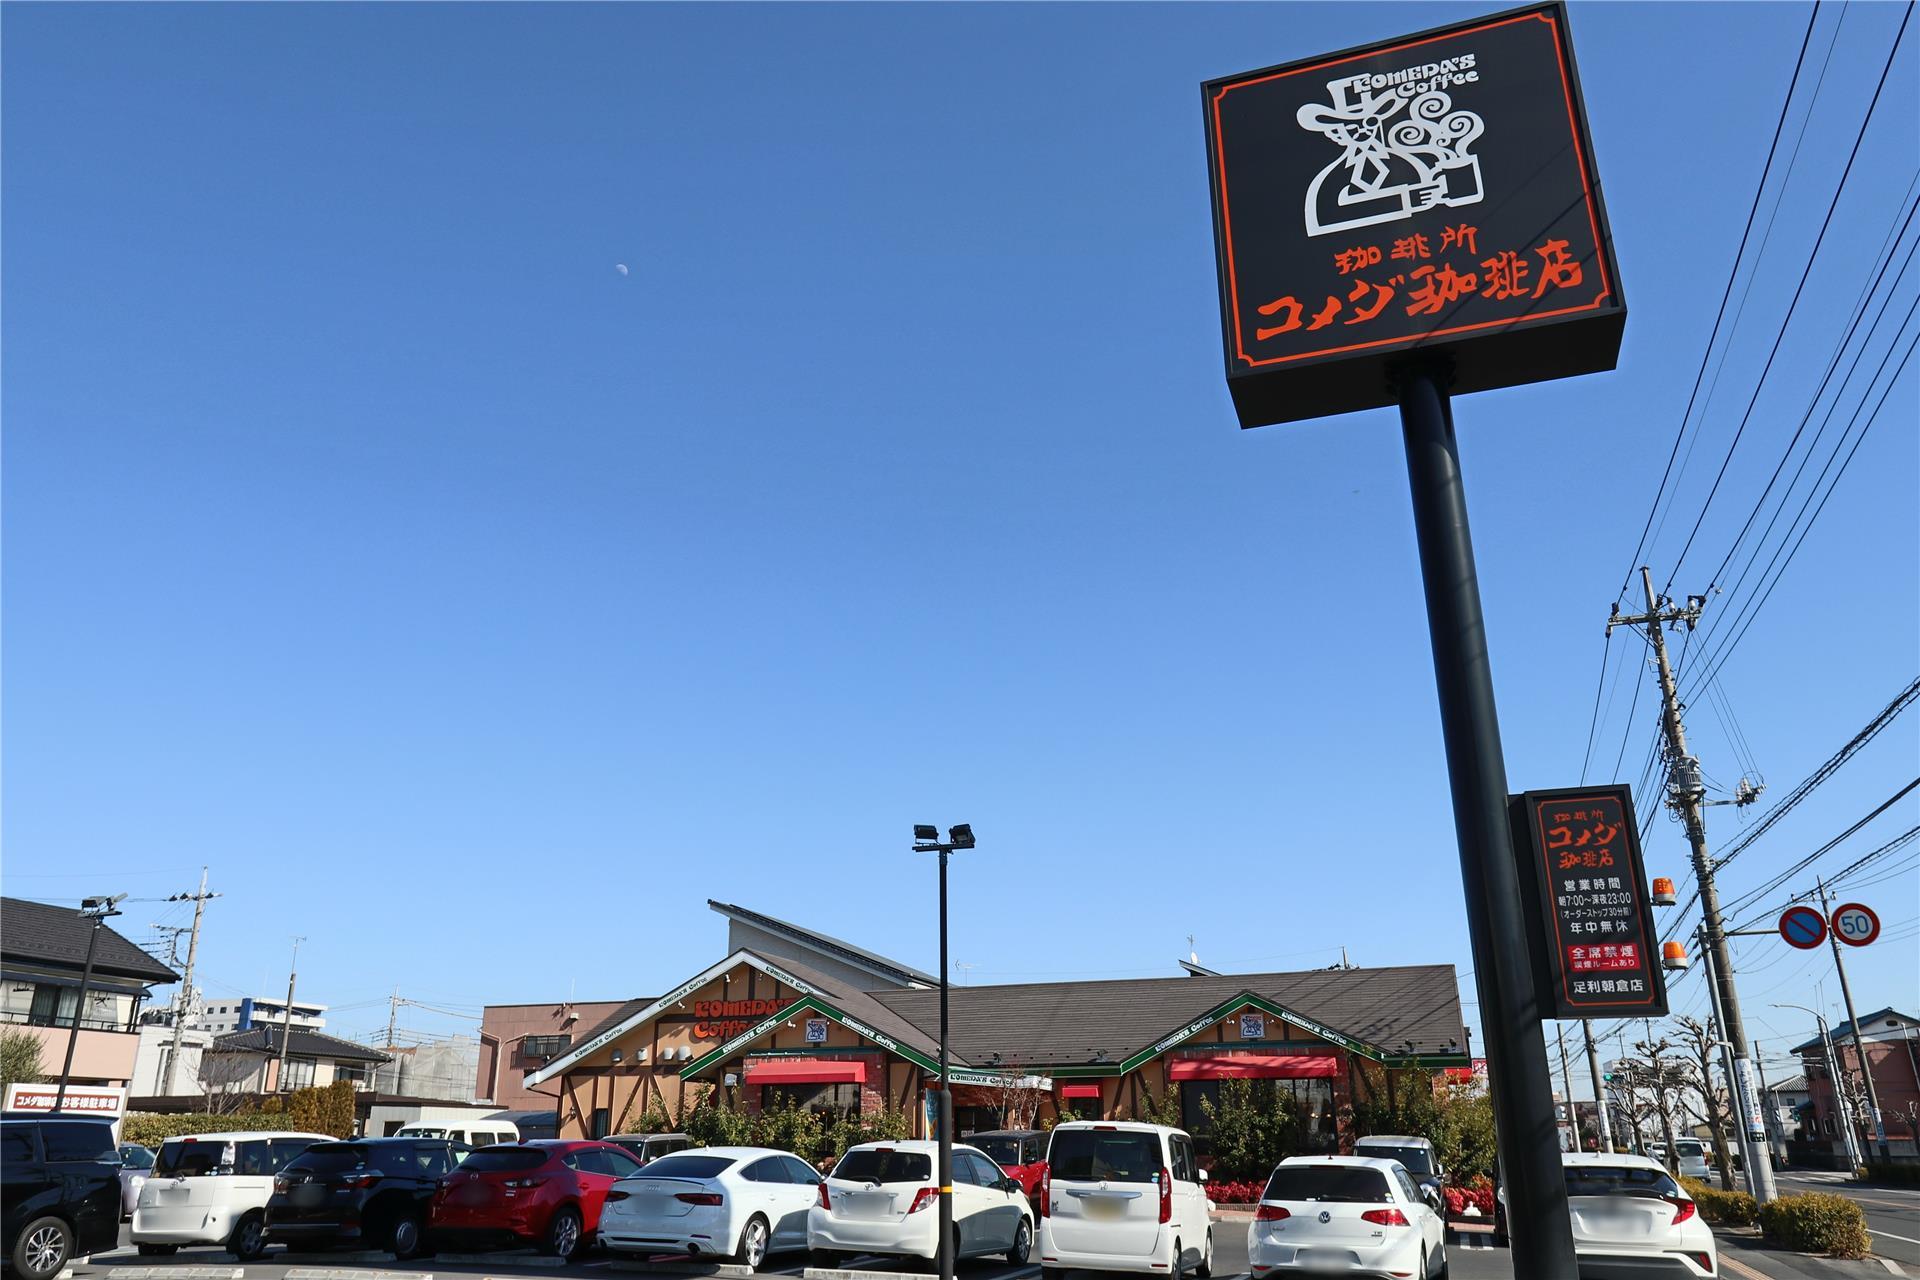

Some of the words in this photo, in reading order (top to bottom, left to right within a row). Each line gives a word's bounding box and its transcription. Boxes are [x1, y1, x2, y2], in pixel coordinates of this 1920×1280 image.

[1353, 53, 1477, 94] KOMEDA'S
[1396, 70, 1480, 98] Coffee
[1333, 223, 1478, 275] 珈琲所
[1256, 239, 1583, 341] コメダ珈琲店
[1549, 822, 1622, 848] コメダ
[1563, 877, 1621, 892] 営業時間
[1569, 919, 1629, 935] 年中無休
[1841, 915, 1869, 935] 50
[1572, 945, 1634, 961] 全席禁煙
[1573, 979, 1644, 994] 足利朝倉店
